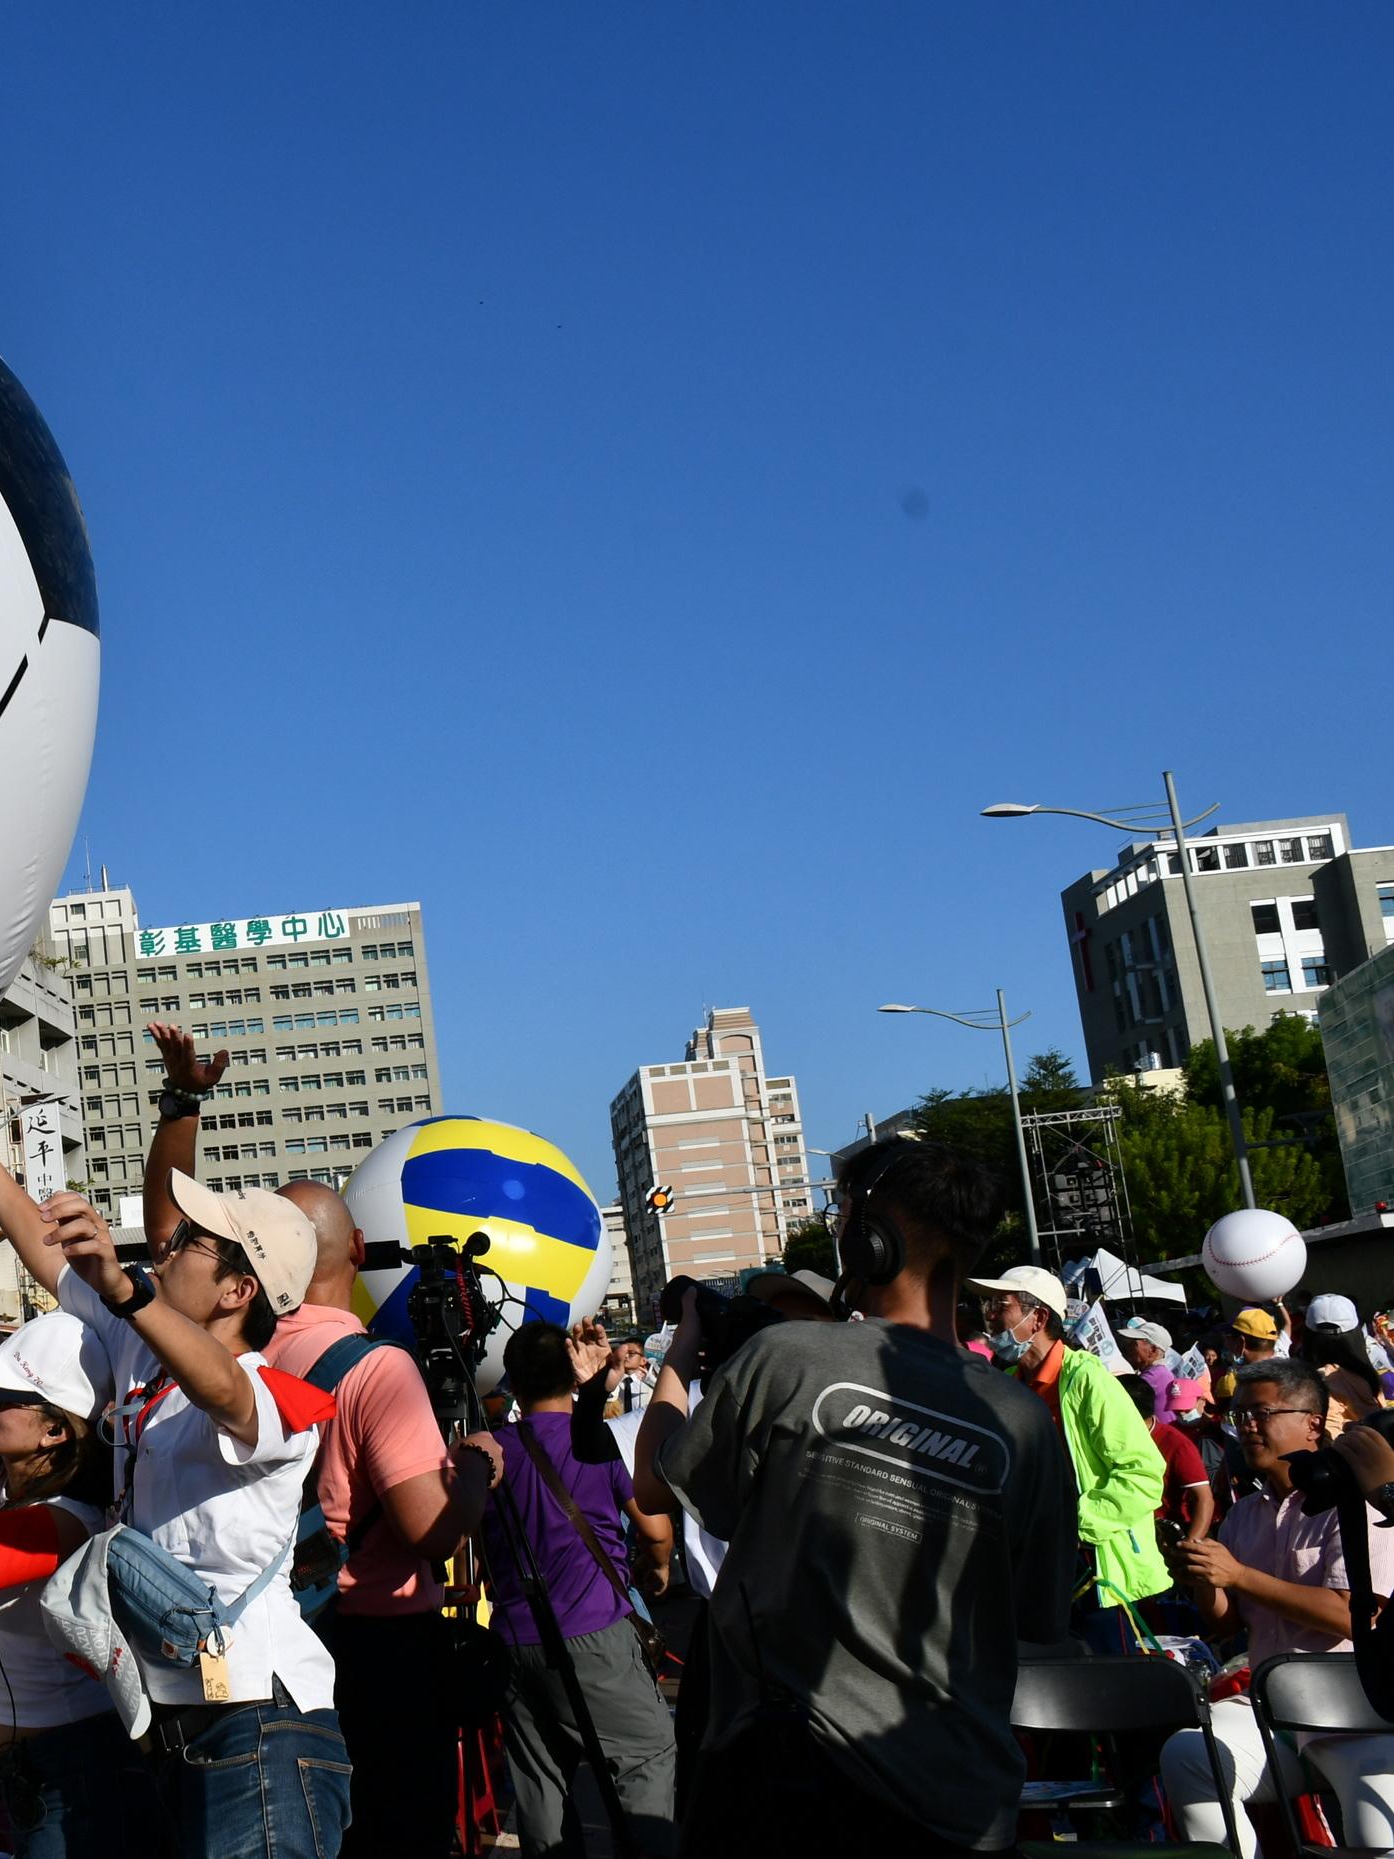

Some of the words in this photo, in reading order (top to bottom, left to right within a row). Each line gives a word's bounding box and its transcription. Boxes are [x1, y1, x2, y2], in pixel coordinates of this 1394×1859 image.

[139, 912, 345, 957] 彰基醫學中心
[842, 1405, 981, 1468] ORIGINAL
[845, 1459, 889, 1480] STANDARD
[890, 1474, 927, 1496] SENSUAL
[860, 1517, 889, 1530] ORIGINAL
[890, 1526, 918, 1540] SYSTEM
